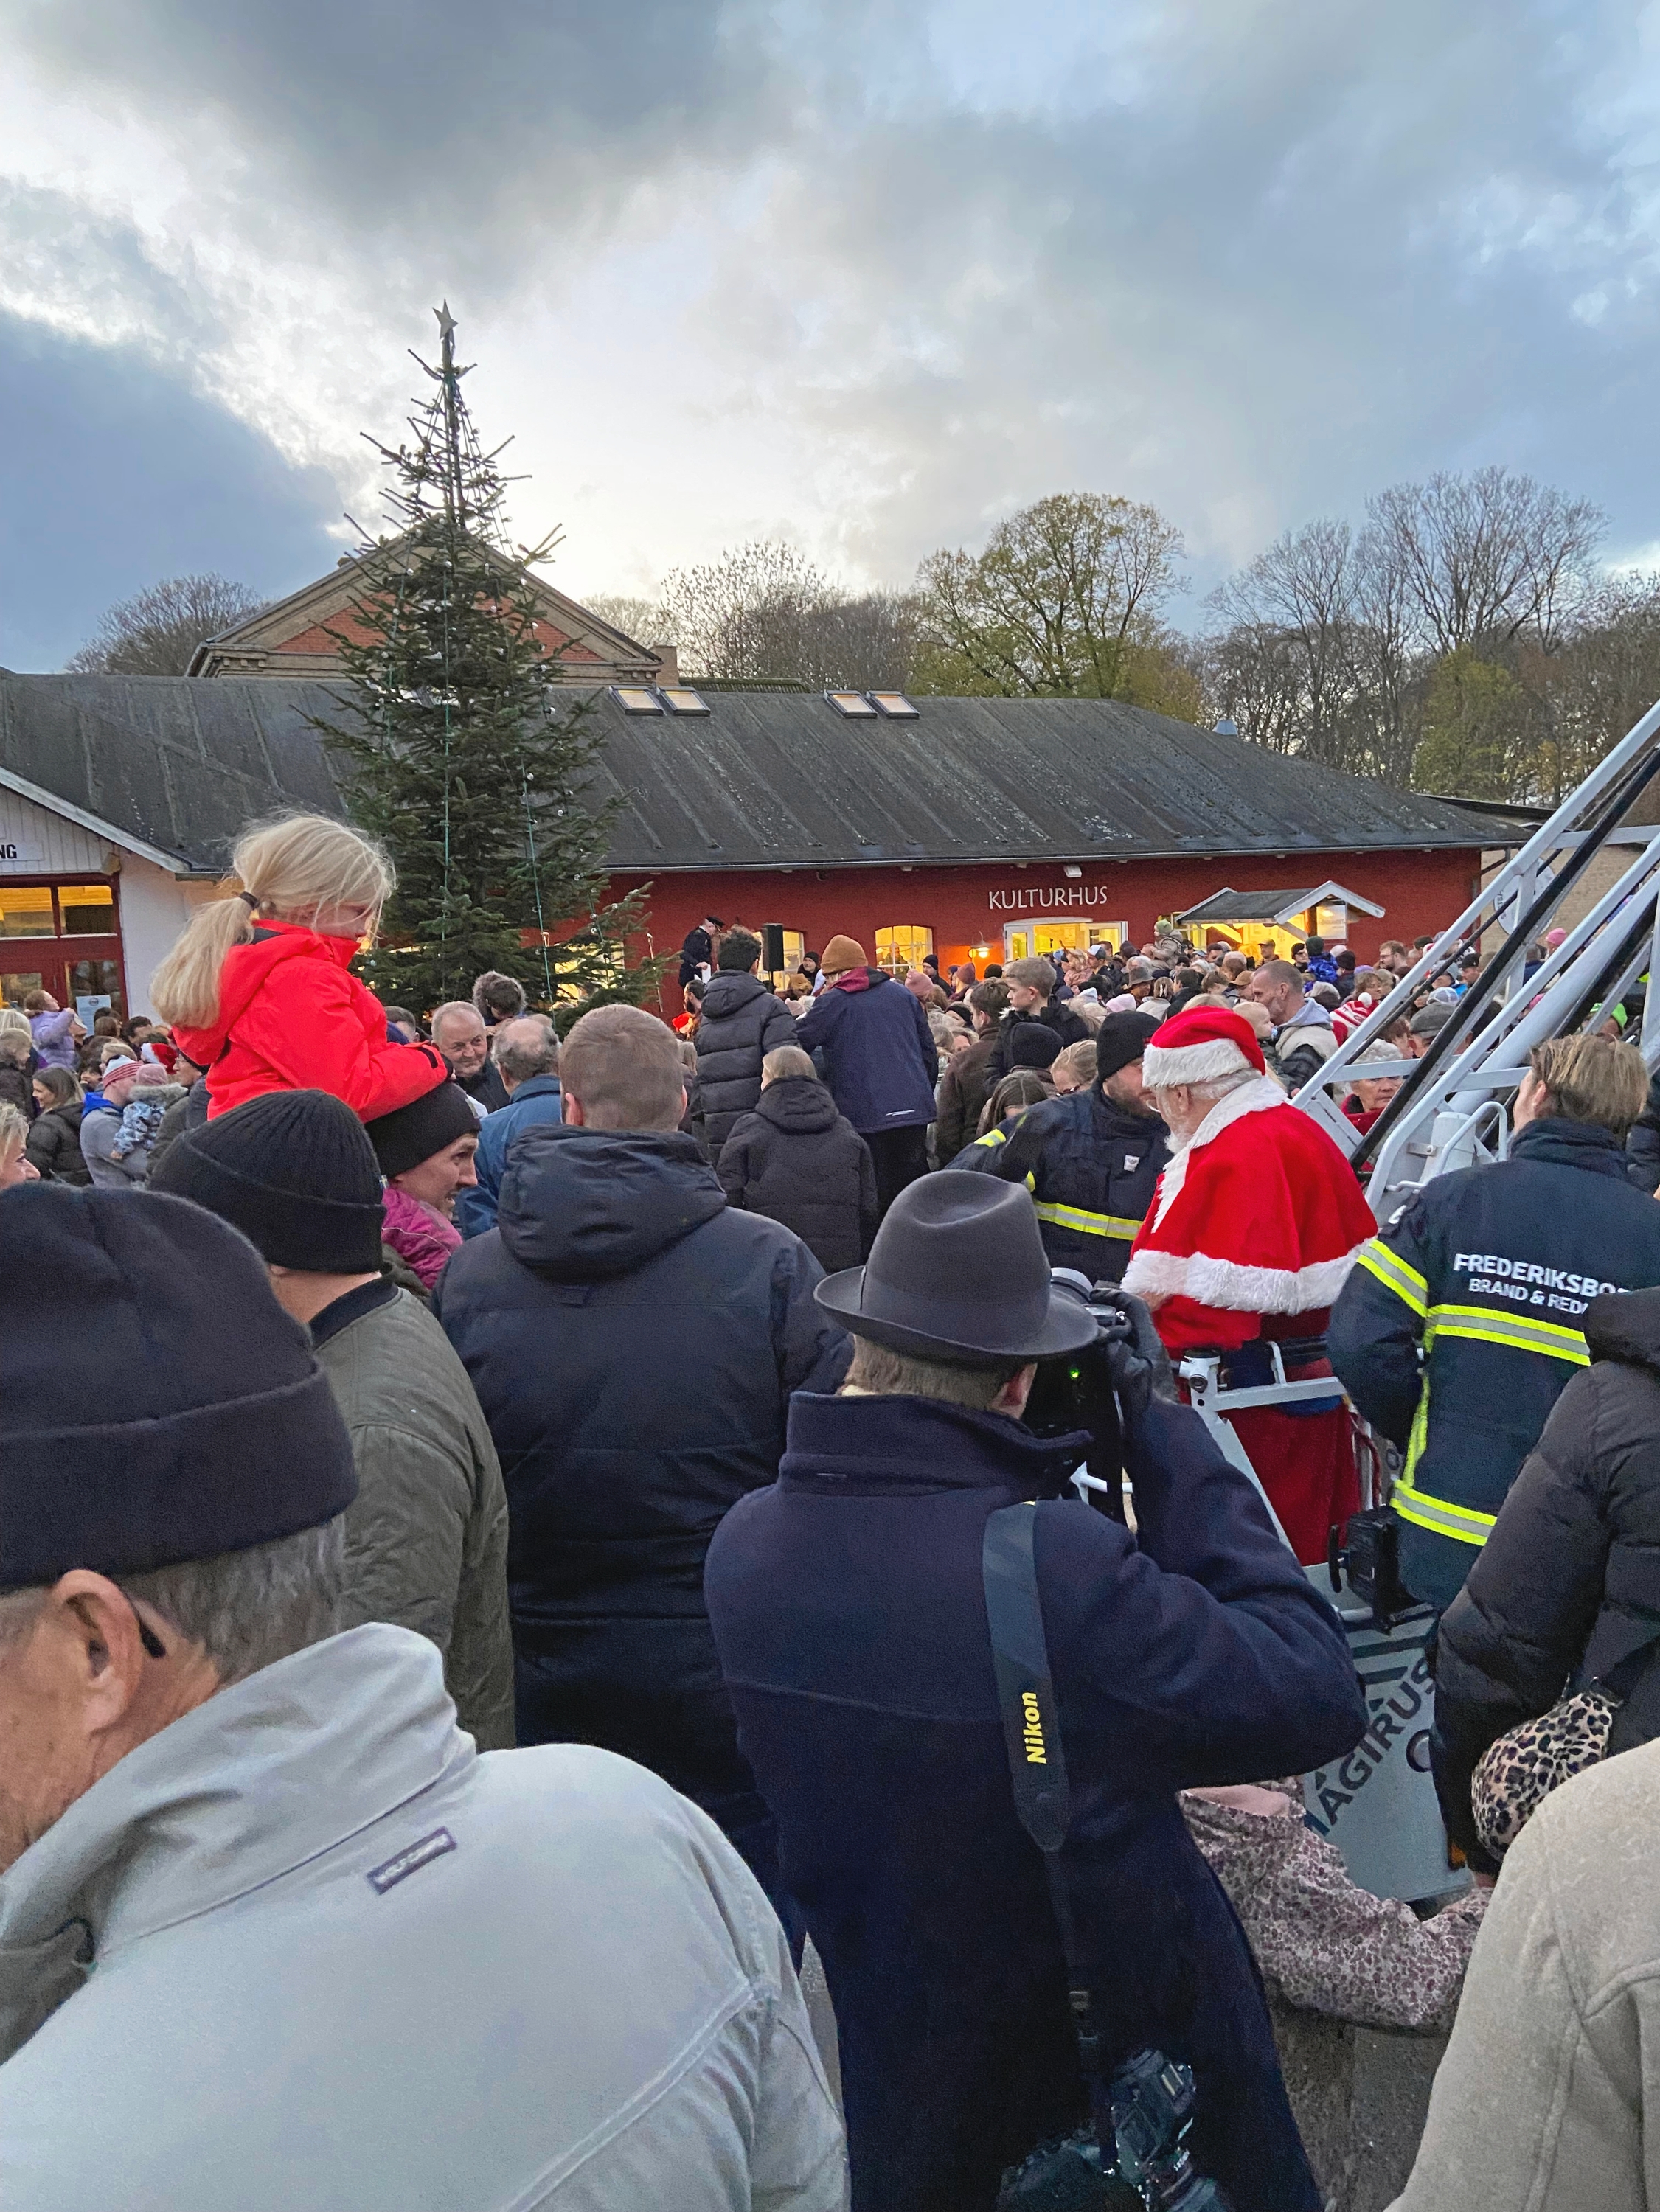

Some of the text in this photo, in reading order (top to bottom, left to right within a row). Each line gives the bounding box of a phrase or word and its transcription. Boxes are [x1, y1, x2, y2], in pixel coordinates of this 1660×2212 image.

[989, 886, 1108, 909] KULTURHUS
[1453, 1253, 1630, 1298] FREDERIKSBO
[1468, 1278, 1529, 1301] BRAND
[1529, 1290, 1545, 1306] &
[1021, 1692, 1047, 1764] Nikon
